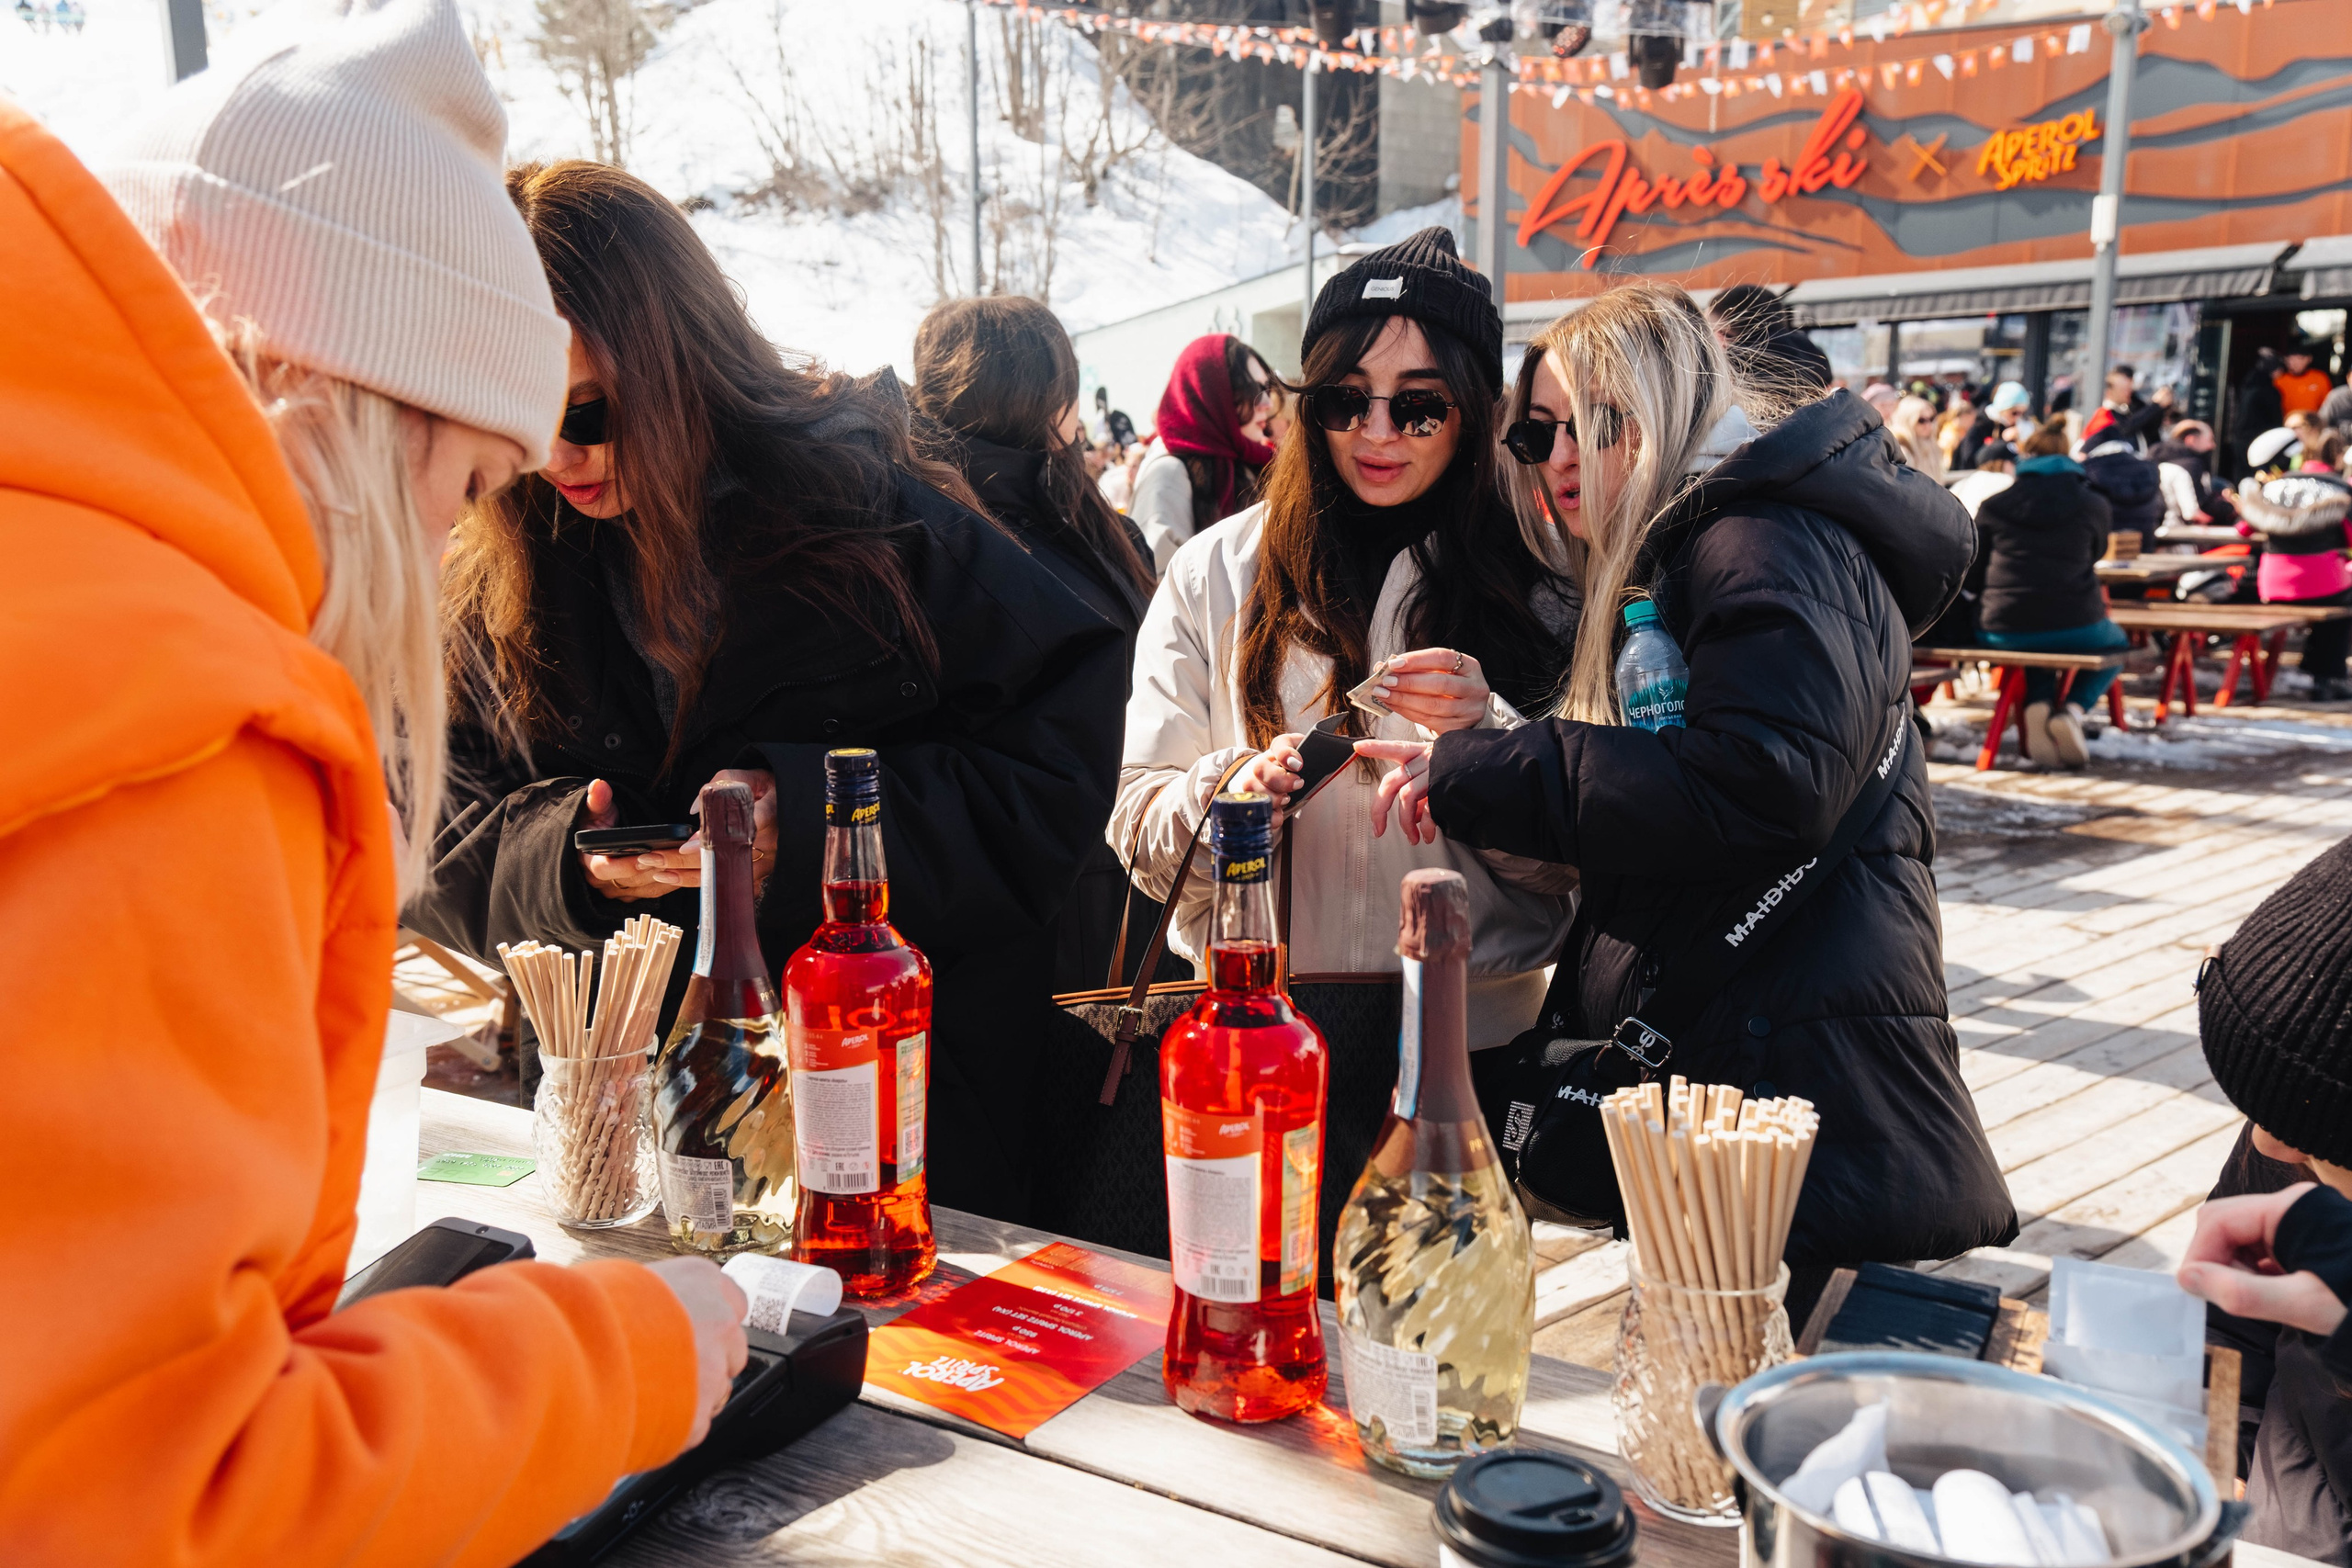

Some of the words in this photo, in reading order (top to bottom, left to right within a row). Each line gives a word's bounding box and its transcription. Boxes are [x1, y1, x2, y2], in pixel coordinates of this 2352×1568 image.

[1758, 89, 1867, 204] ski
[1976, 107, 2100, 175] APEROL
[1996, 141, 2078, 191] SPRITZ
[851, 801, 880, 822] APERO
[1226, 856, 1267, 877] APEROL
[841, 1033, 869, 1047] APEROL
[1218, 1122, 1250, 1136] APEROL
[1026, 1316, 1058, 1330] SPRITZ
[1057, 1325, 1094, 1341] APEROL
[973, 1329, 1005, 1343] SPRITZ
[1004, 1338, 1041, 1355] APEROL
[902, 1360, 1005, 1392] APEROL
[930, 1356, 1000, 1380] SPRITZ
